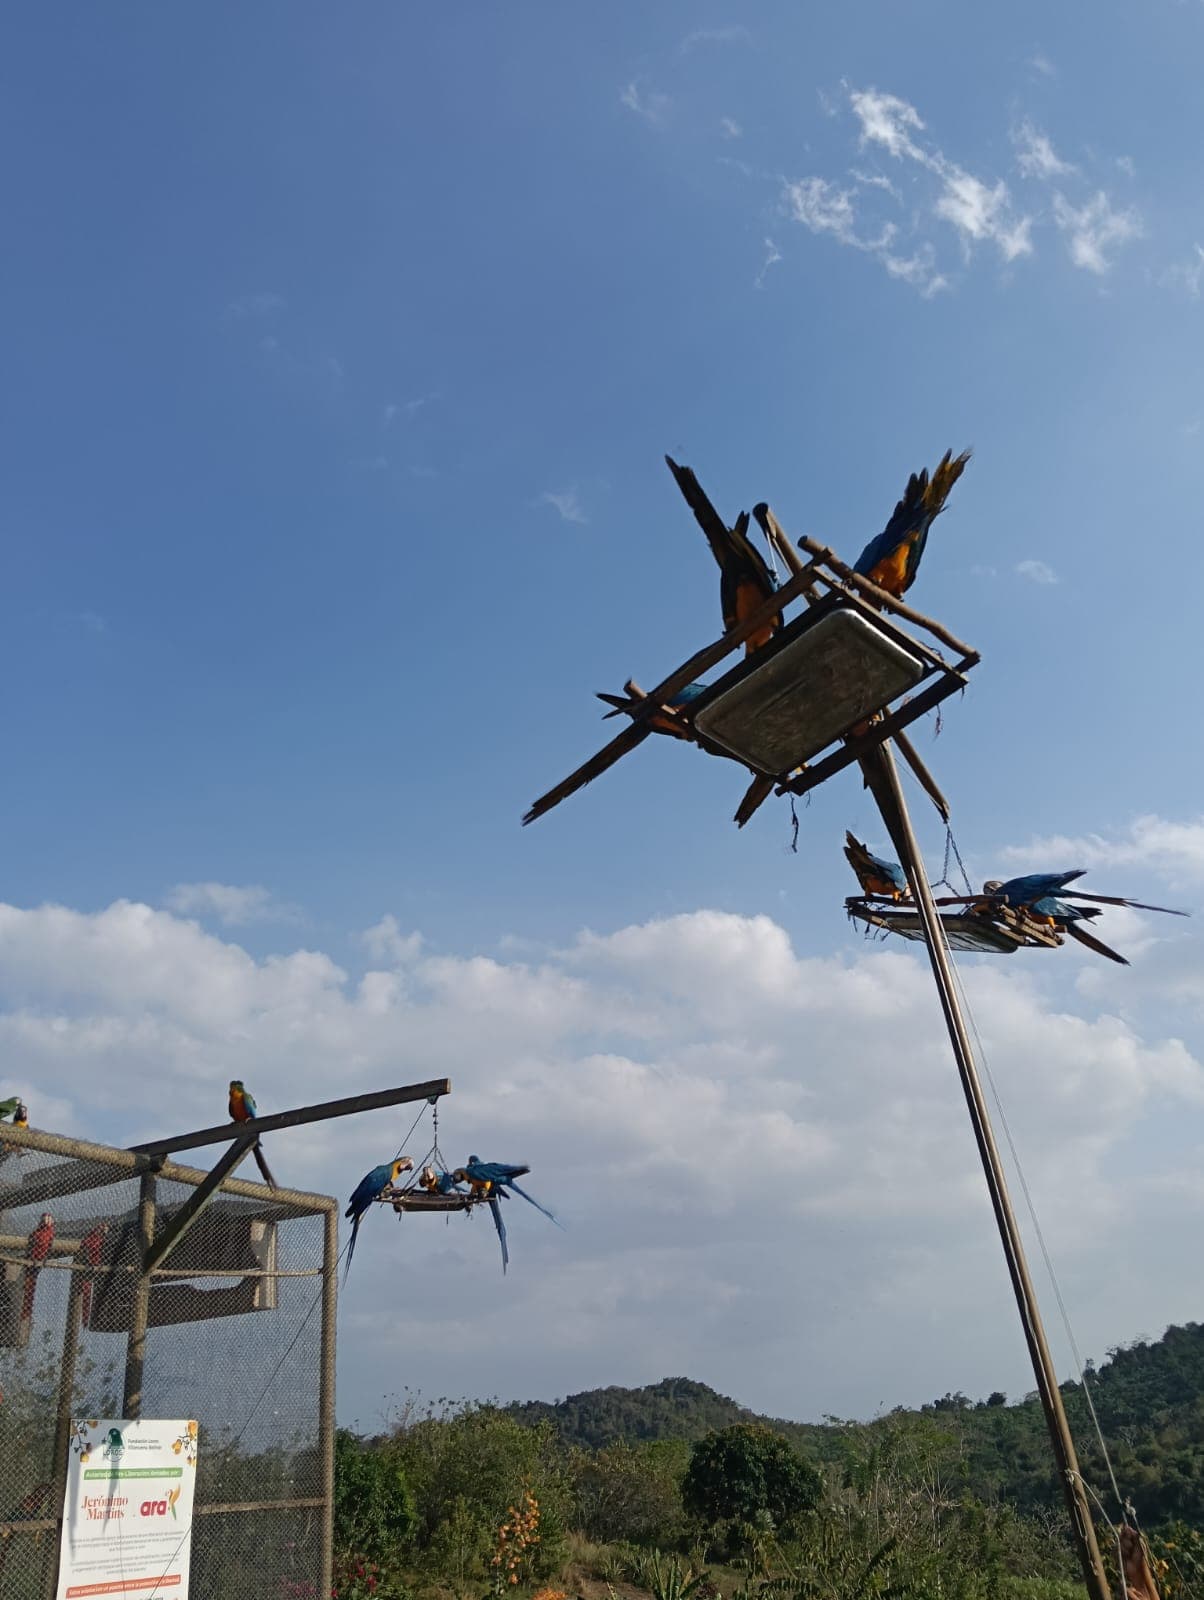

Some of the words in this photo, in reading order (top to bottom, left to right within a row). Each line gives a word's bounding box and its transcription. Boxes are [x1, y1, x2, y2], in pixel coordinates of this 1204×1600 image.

[81, 1496, 129, 1509] Jerónimo
[140, 1500, 167, 1517] ara
[86, 1507, 125, 1521] Martins
